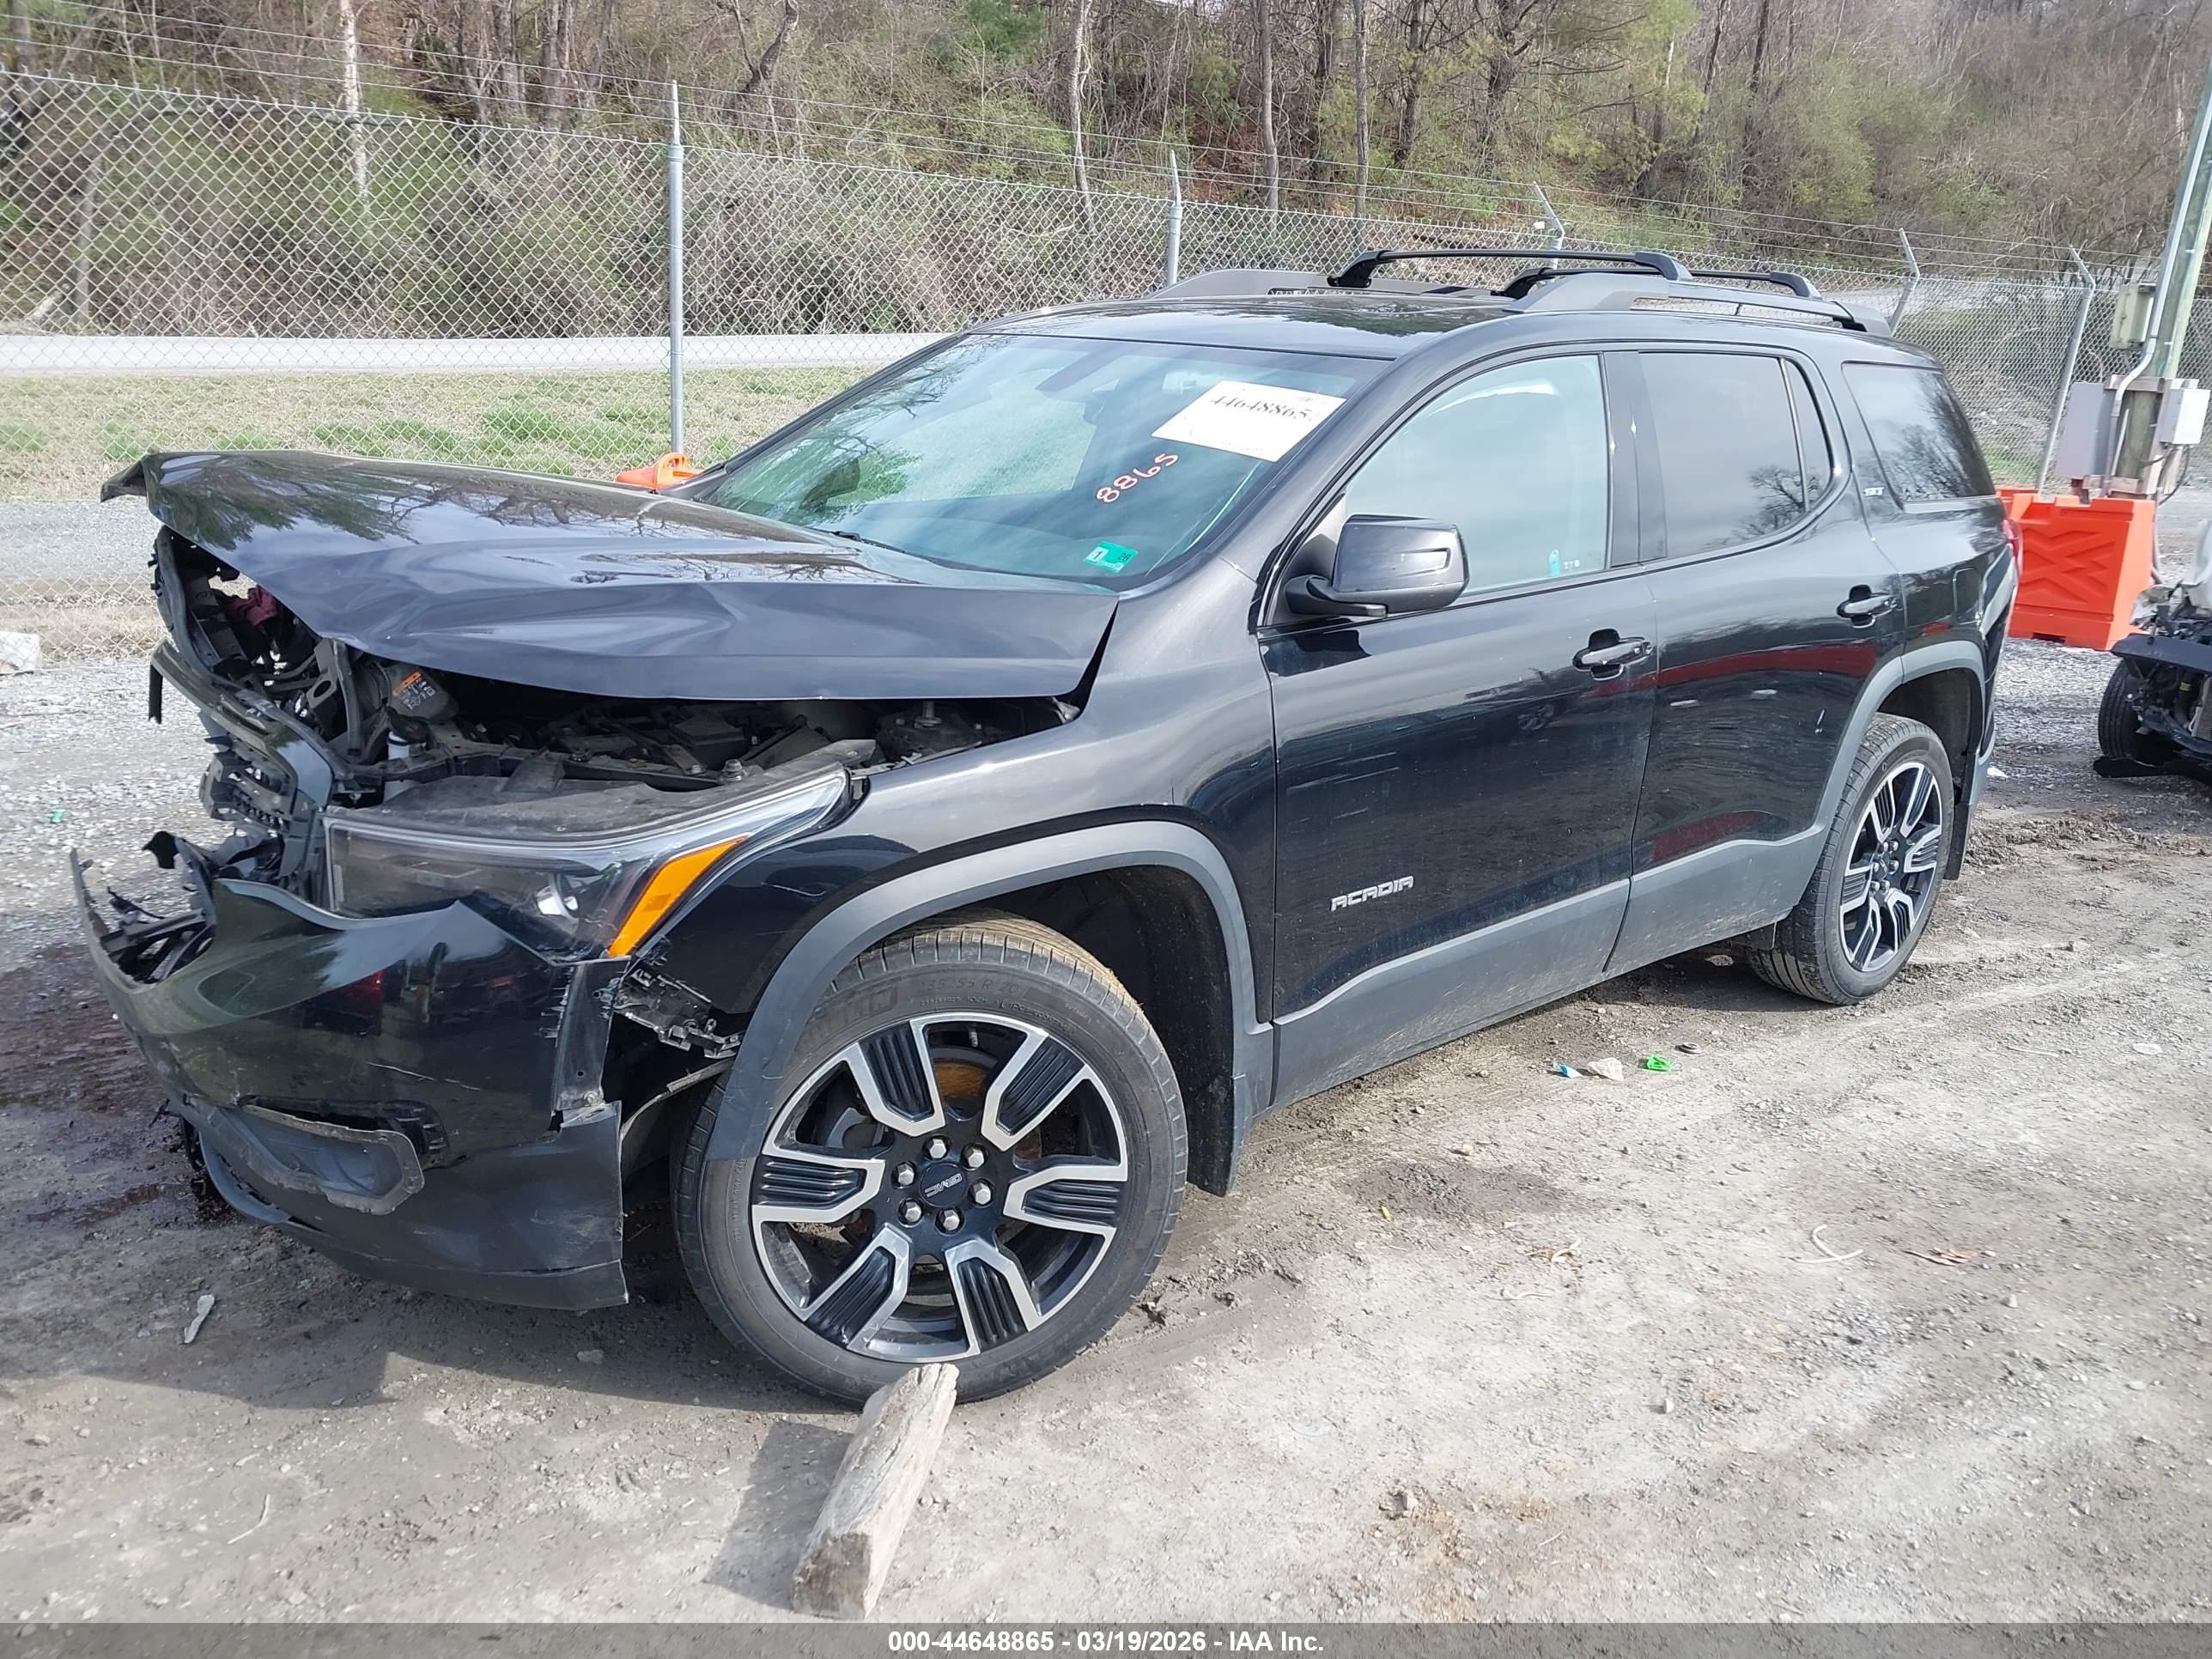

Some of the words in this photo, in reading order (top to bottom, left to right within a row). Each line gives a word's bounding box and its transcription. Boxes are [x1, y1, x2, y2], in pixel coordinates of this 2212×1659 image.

[1211, 394, 1314, 422] 44648865
[1096, 453, 1179, 503] 8865
[1330, 875, 1414, 912] ACADIA
[924, 1173, 963, 1198] GMC
